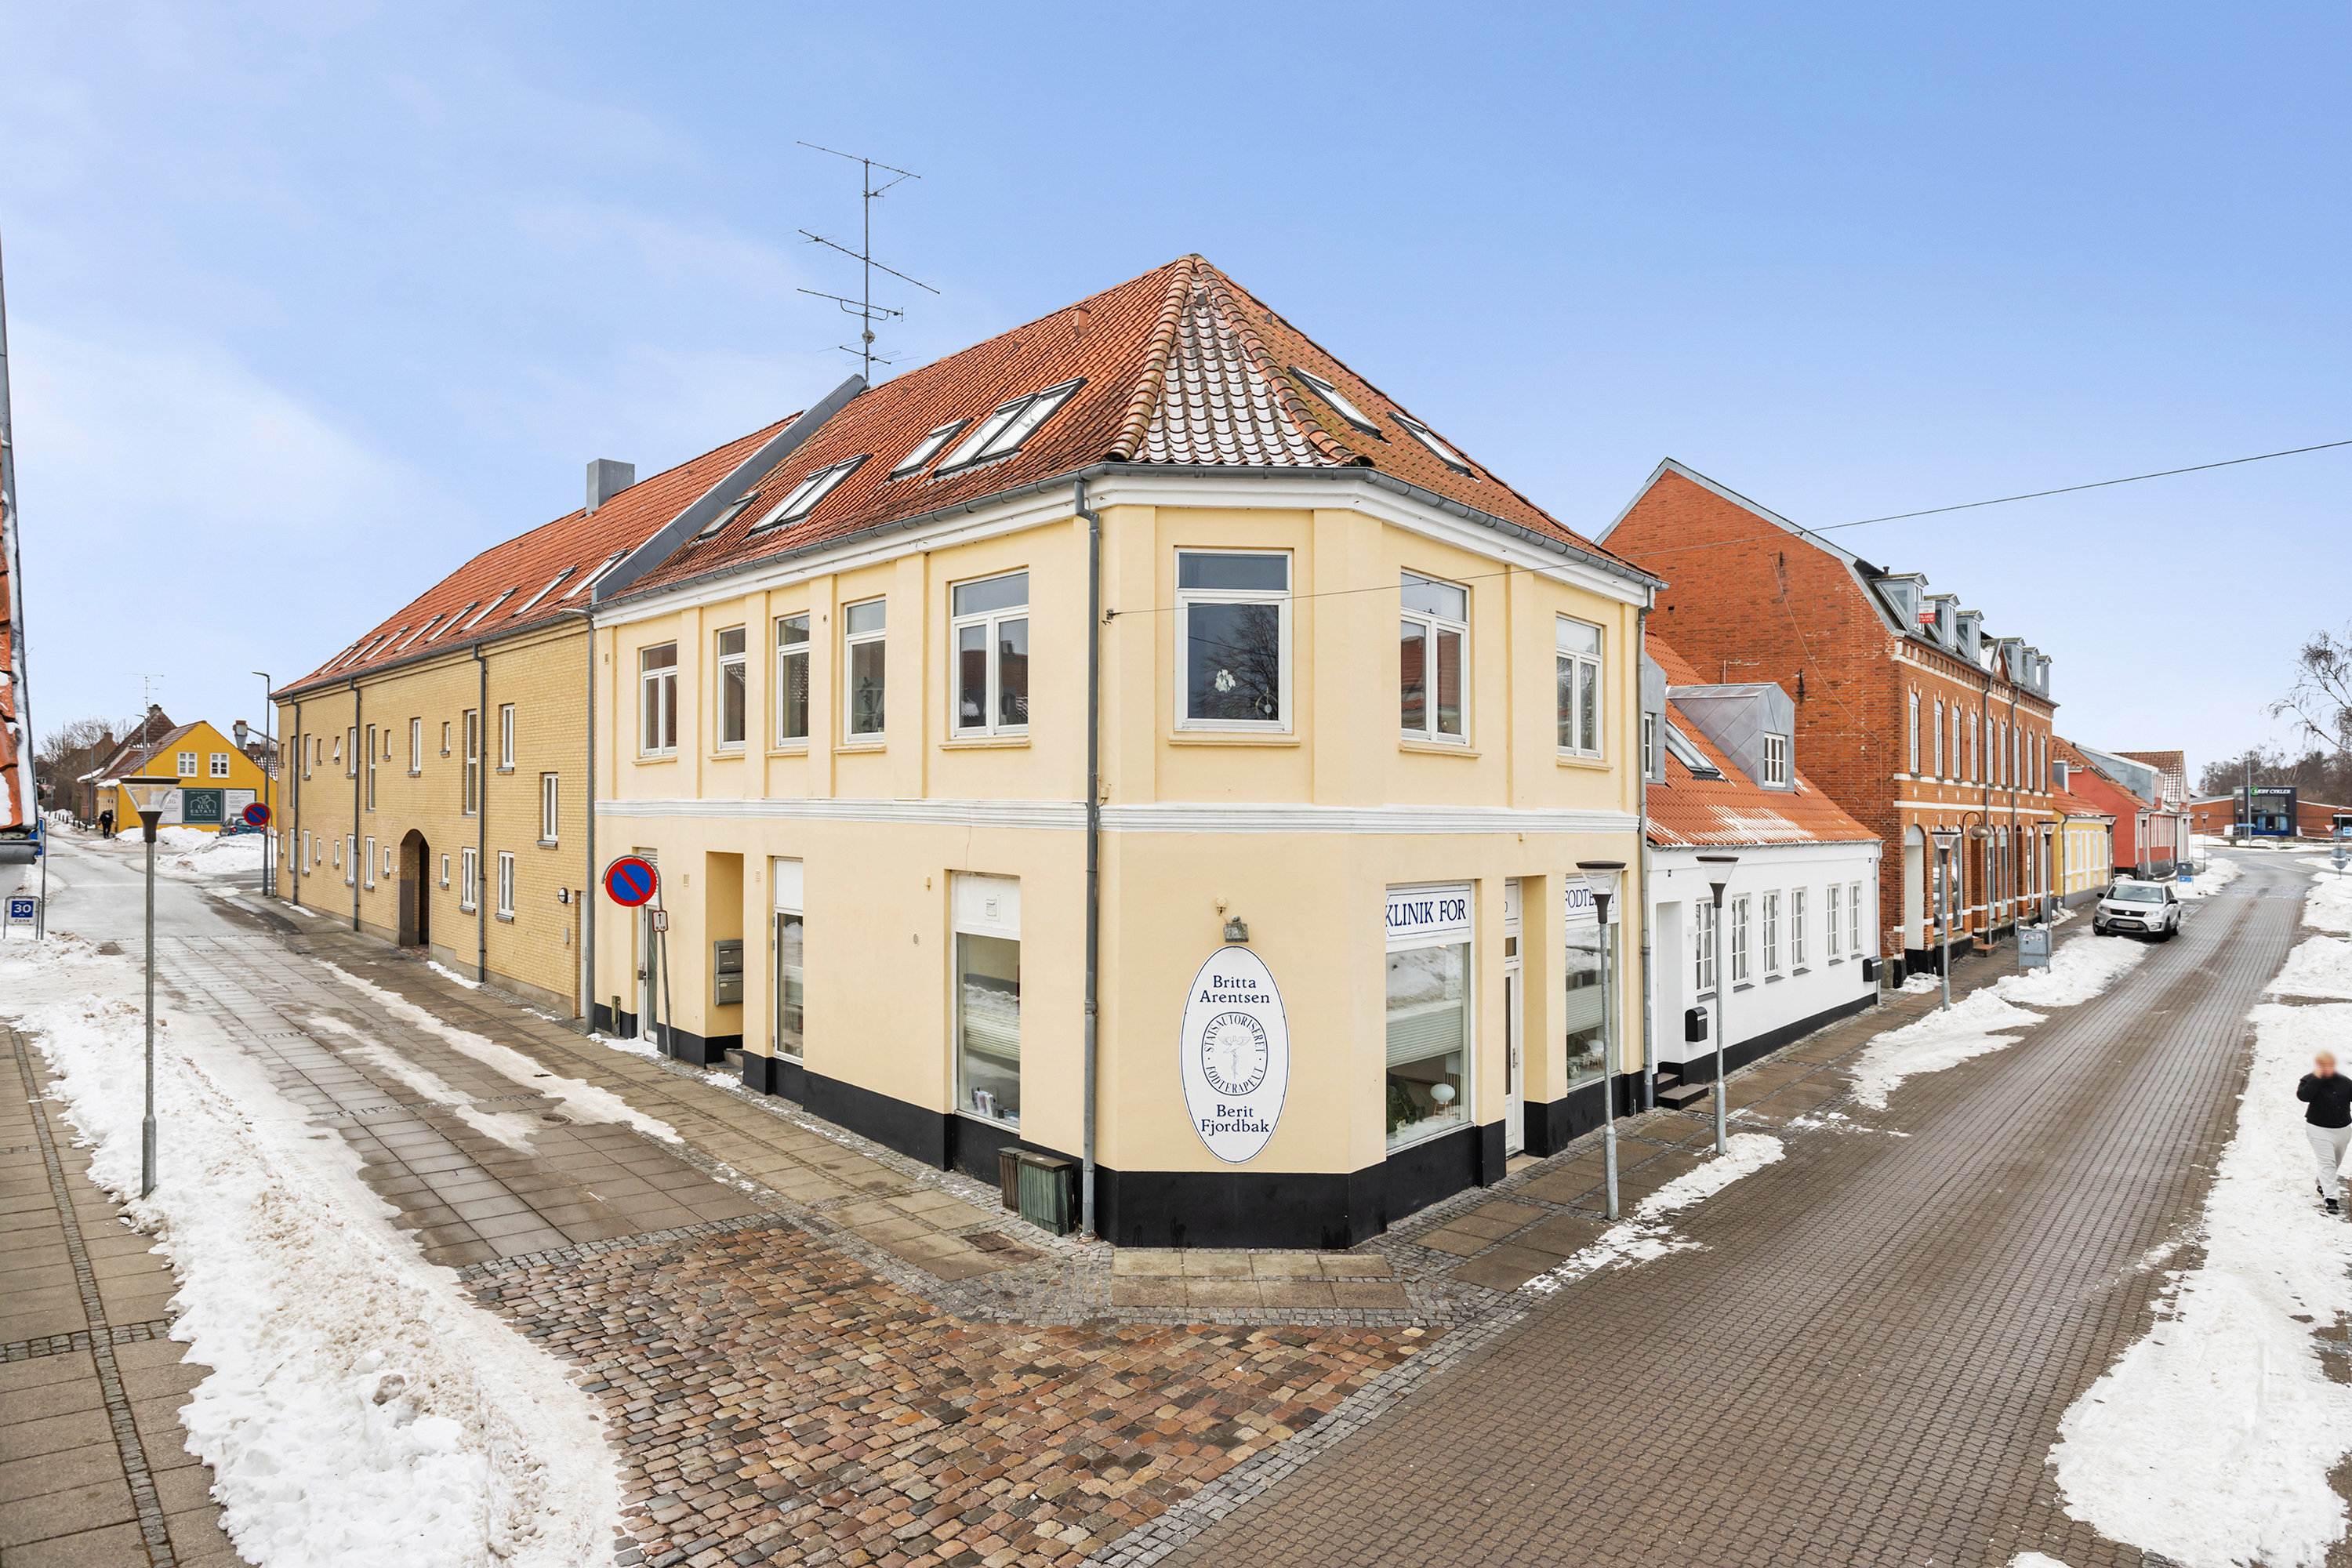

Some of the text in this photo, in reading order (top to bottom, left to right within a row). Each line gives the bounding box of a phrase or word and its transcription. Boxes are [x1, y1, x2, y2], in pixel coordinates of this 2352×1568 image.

[14, 904, 31, 913] 30
[1386, 899, 1466, 927] KLINIK FOR
[1213, 975, 1256, 988] Britta
[1200, 989, 1270, 1004] Arentsen
[1204, 1014, 1265, 1053] STATSAUTORISERET
[1206, 1066, 1263, 1094] FODTERAPEUT
[1217, 1104, 1254, 1117] Berit
[1201, 1119, 1269, 1136] Fjordbak
